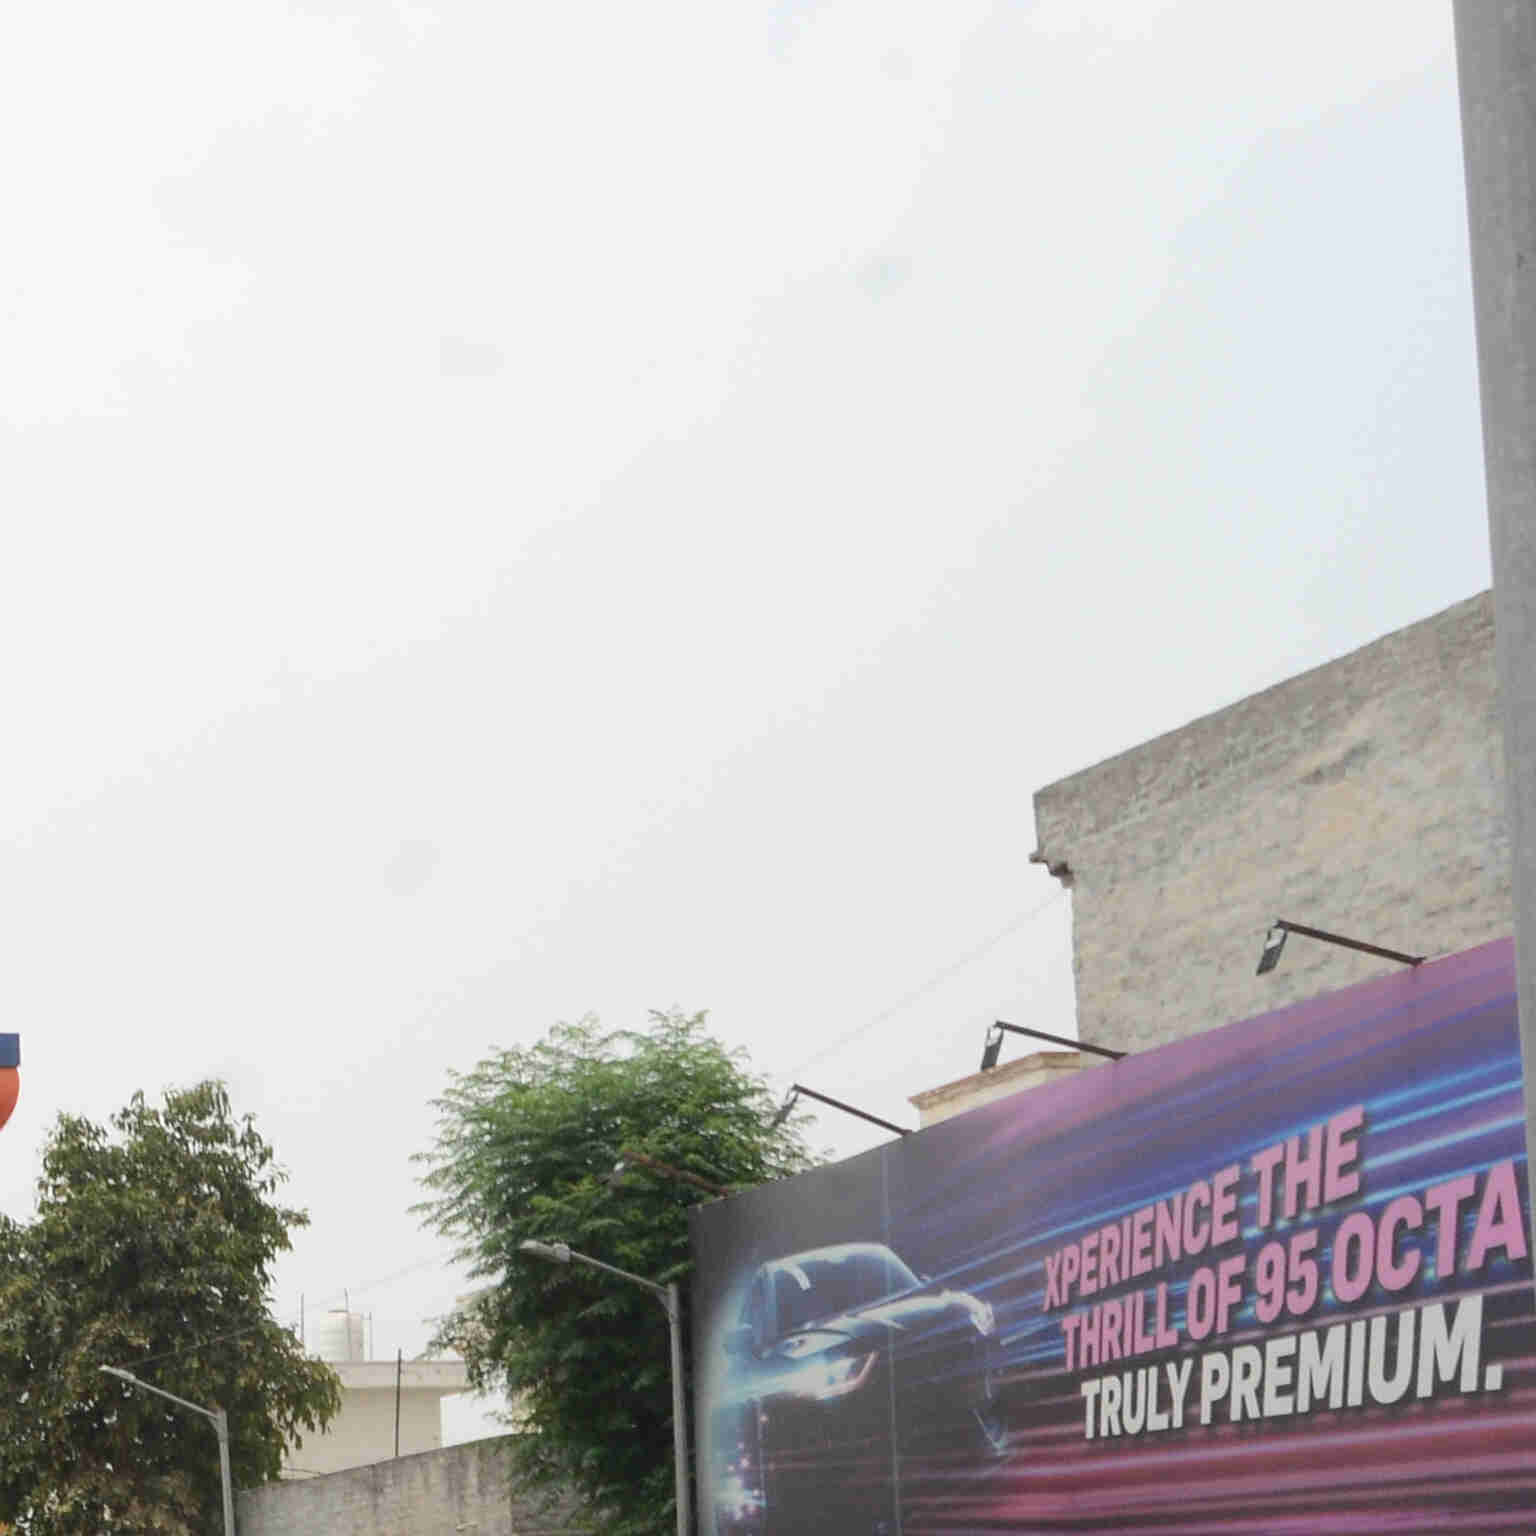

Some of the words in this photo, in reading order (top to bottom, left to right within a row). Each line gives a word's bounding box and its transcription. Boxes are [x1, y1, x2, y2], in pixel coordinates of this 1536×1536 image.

[1043, 1164, 1241, 1312] XPERIENCE
[1251, 1104, 1365, 1228] THE
[1061, 1282, 1179, 1371] THRILL
[1186, 1255, 1247, 1340] OF
[1255, 1228, 1319, 1323] 95
[1331, 1158, 1528, 1303] OCTA
[1080, 1358, 1194, 1439] TRULY
[1199, 1294, 1503, 1426] PREMIUM.
